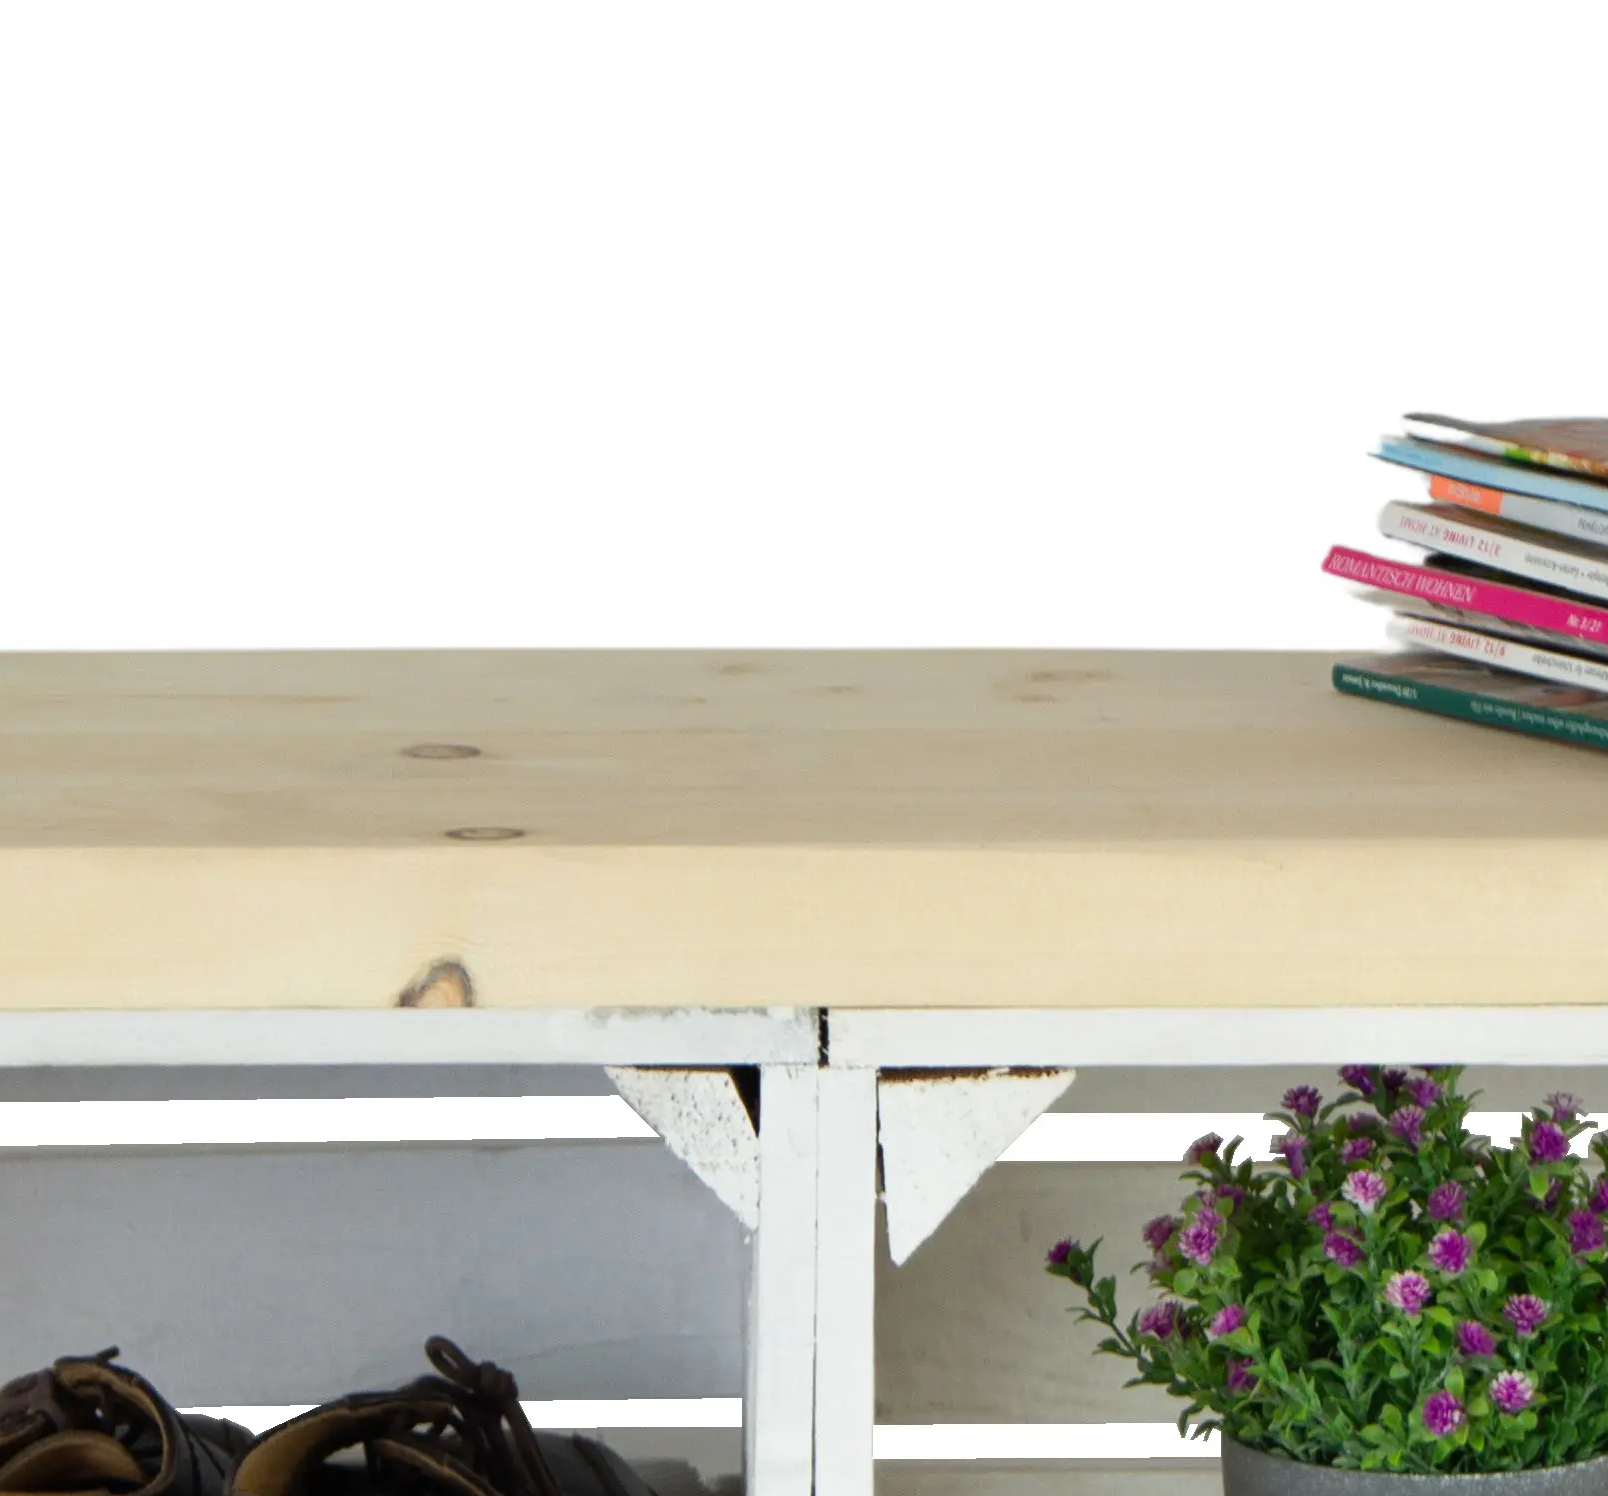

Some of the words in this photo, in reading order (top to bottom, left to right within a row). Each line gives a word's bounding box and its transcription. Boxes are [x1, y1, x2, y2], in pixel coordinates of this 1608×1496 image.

[1441, 527, 1474, 550] LIVING
[1329, 553, 1412, 587] ROMANTISCH
[1414, 573, 1475, 603] WOHNEN
[1449, 631, 1479, 651] LIVING
